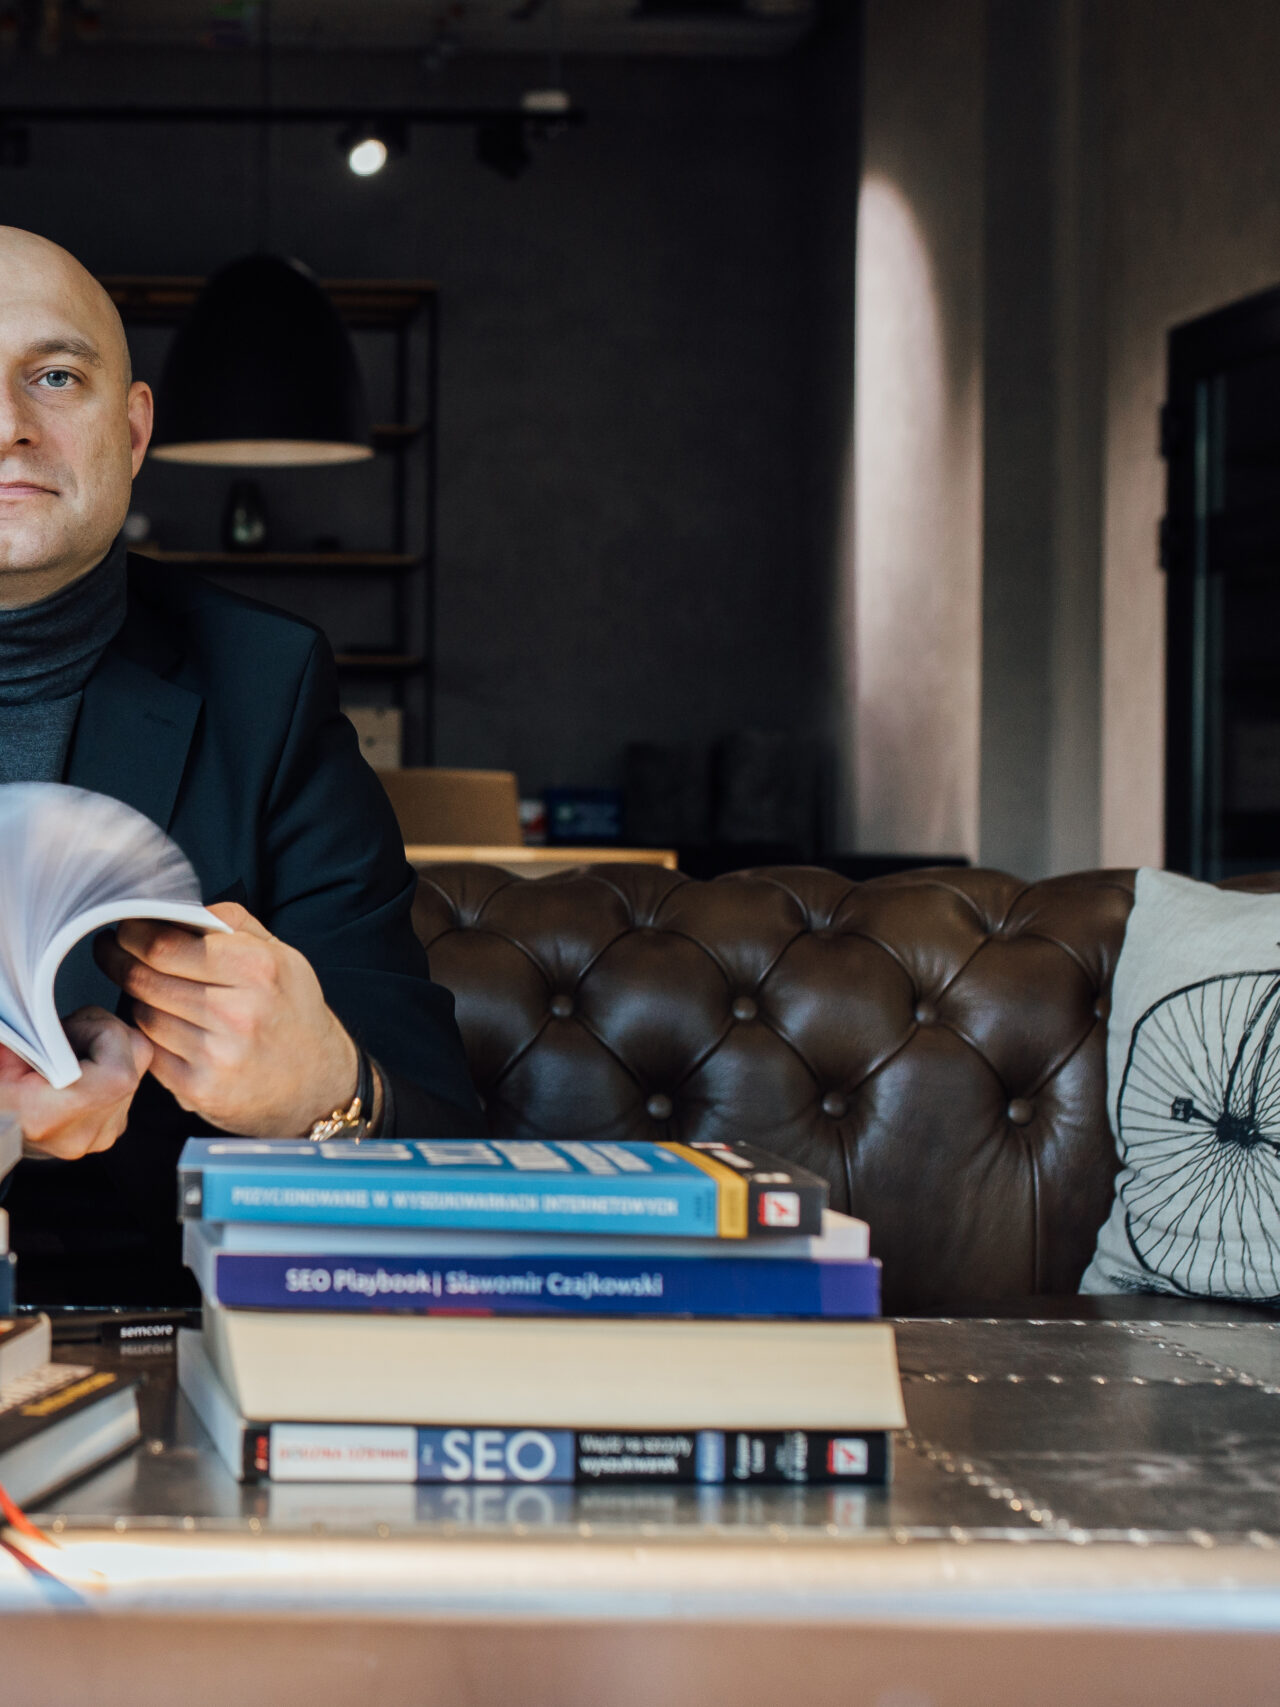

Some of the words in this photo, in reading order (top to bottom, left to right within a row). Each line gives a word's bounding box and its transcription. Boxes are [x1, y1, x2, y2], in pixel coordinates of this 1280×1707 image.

[285, 1268, 332, 1292] SEO
[333, 1269, 433, 1297] Playbook
[546, 1272, 663, 1299] Czajkowski
[120, 1325, 174, 1338] semcore
[441, 1431, 556, 1482] SEO
